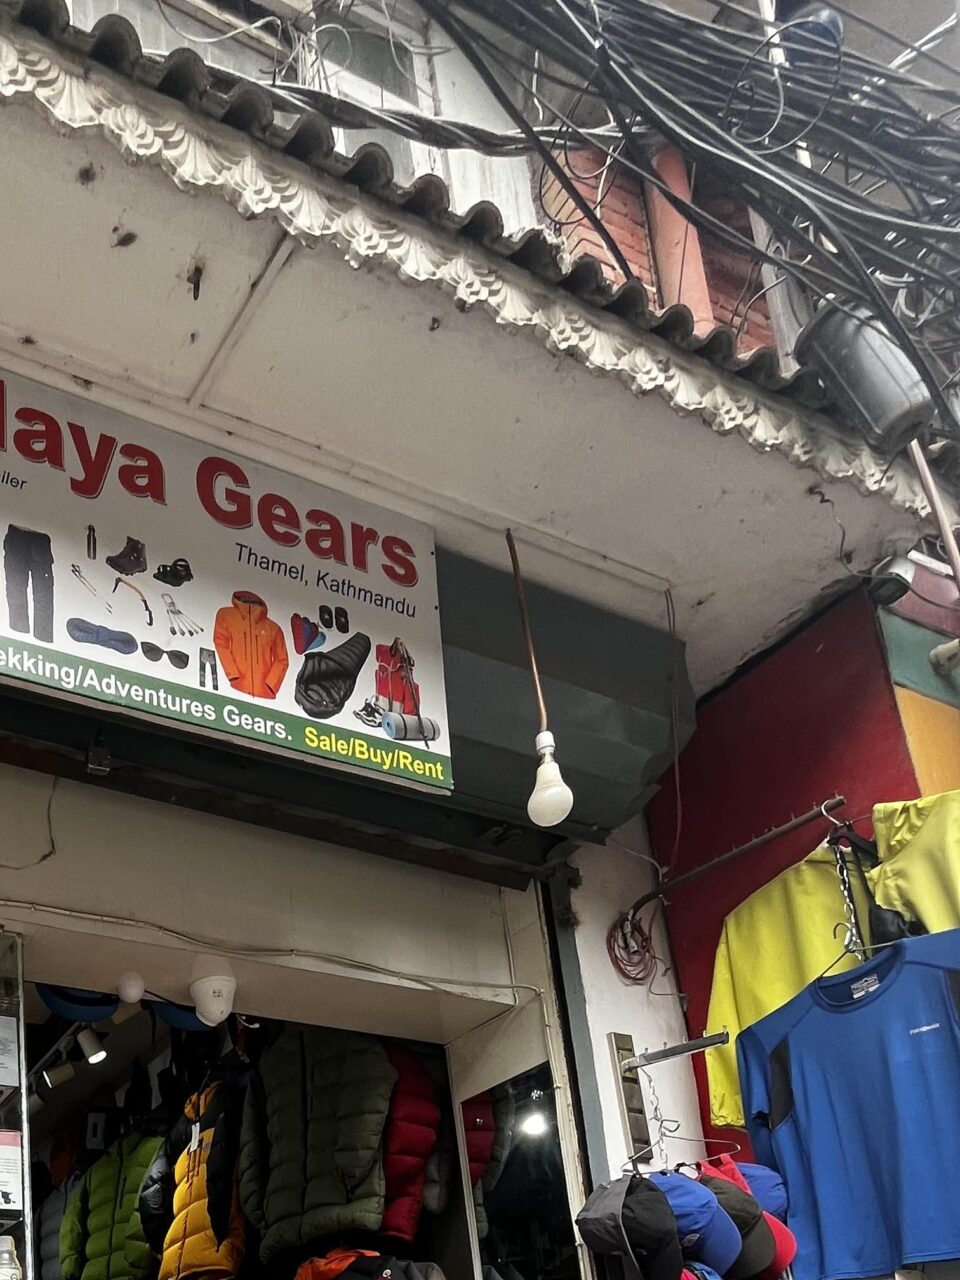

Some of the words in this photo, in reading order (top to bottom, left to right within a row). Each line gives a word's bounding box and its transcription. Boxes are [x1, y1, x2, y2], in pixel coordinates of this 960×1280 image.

[196, 456, 418, 587] Gears
[235, 542, 309, 586] Thamel,
[316, 569, 417, 619] Kathmandu
[222, 704, 292, 741] Gears.
[304, 727, 445, 781] Sale/Buy/Rent
